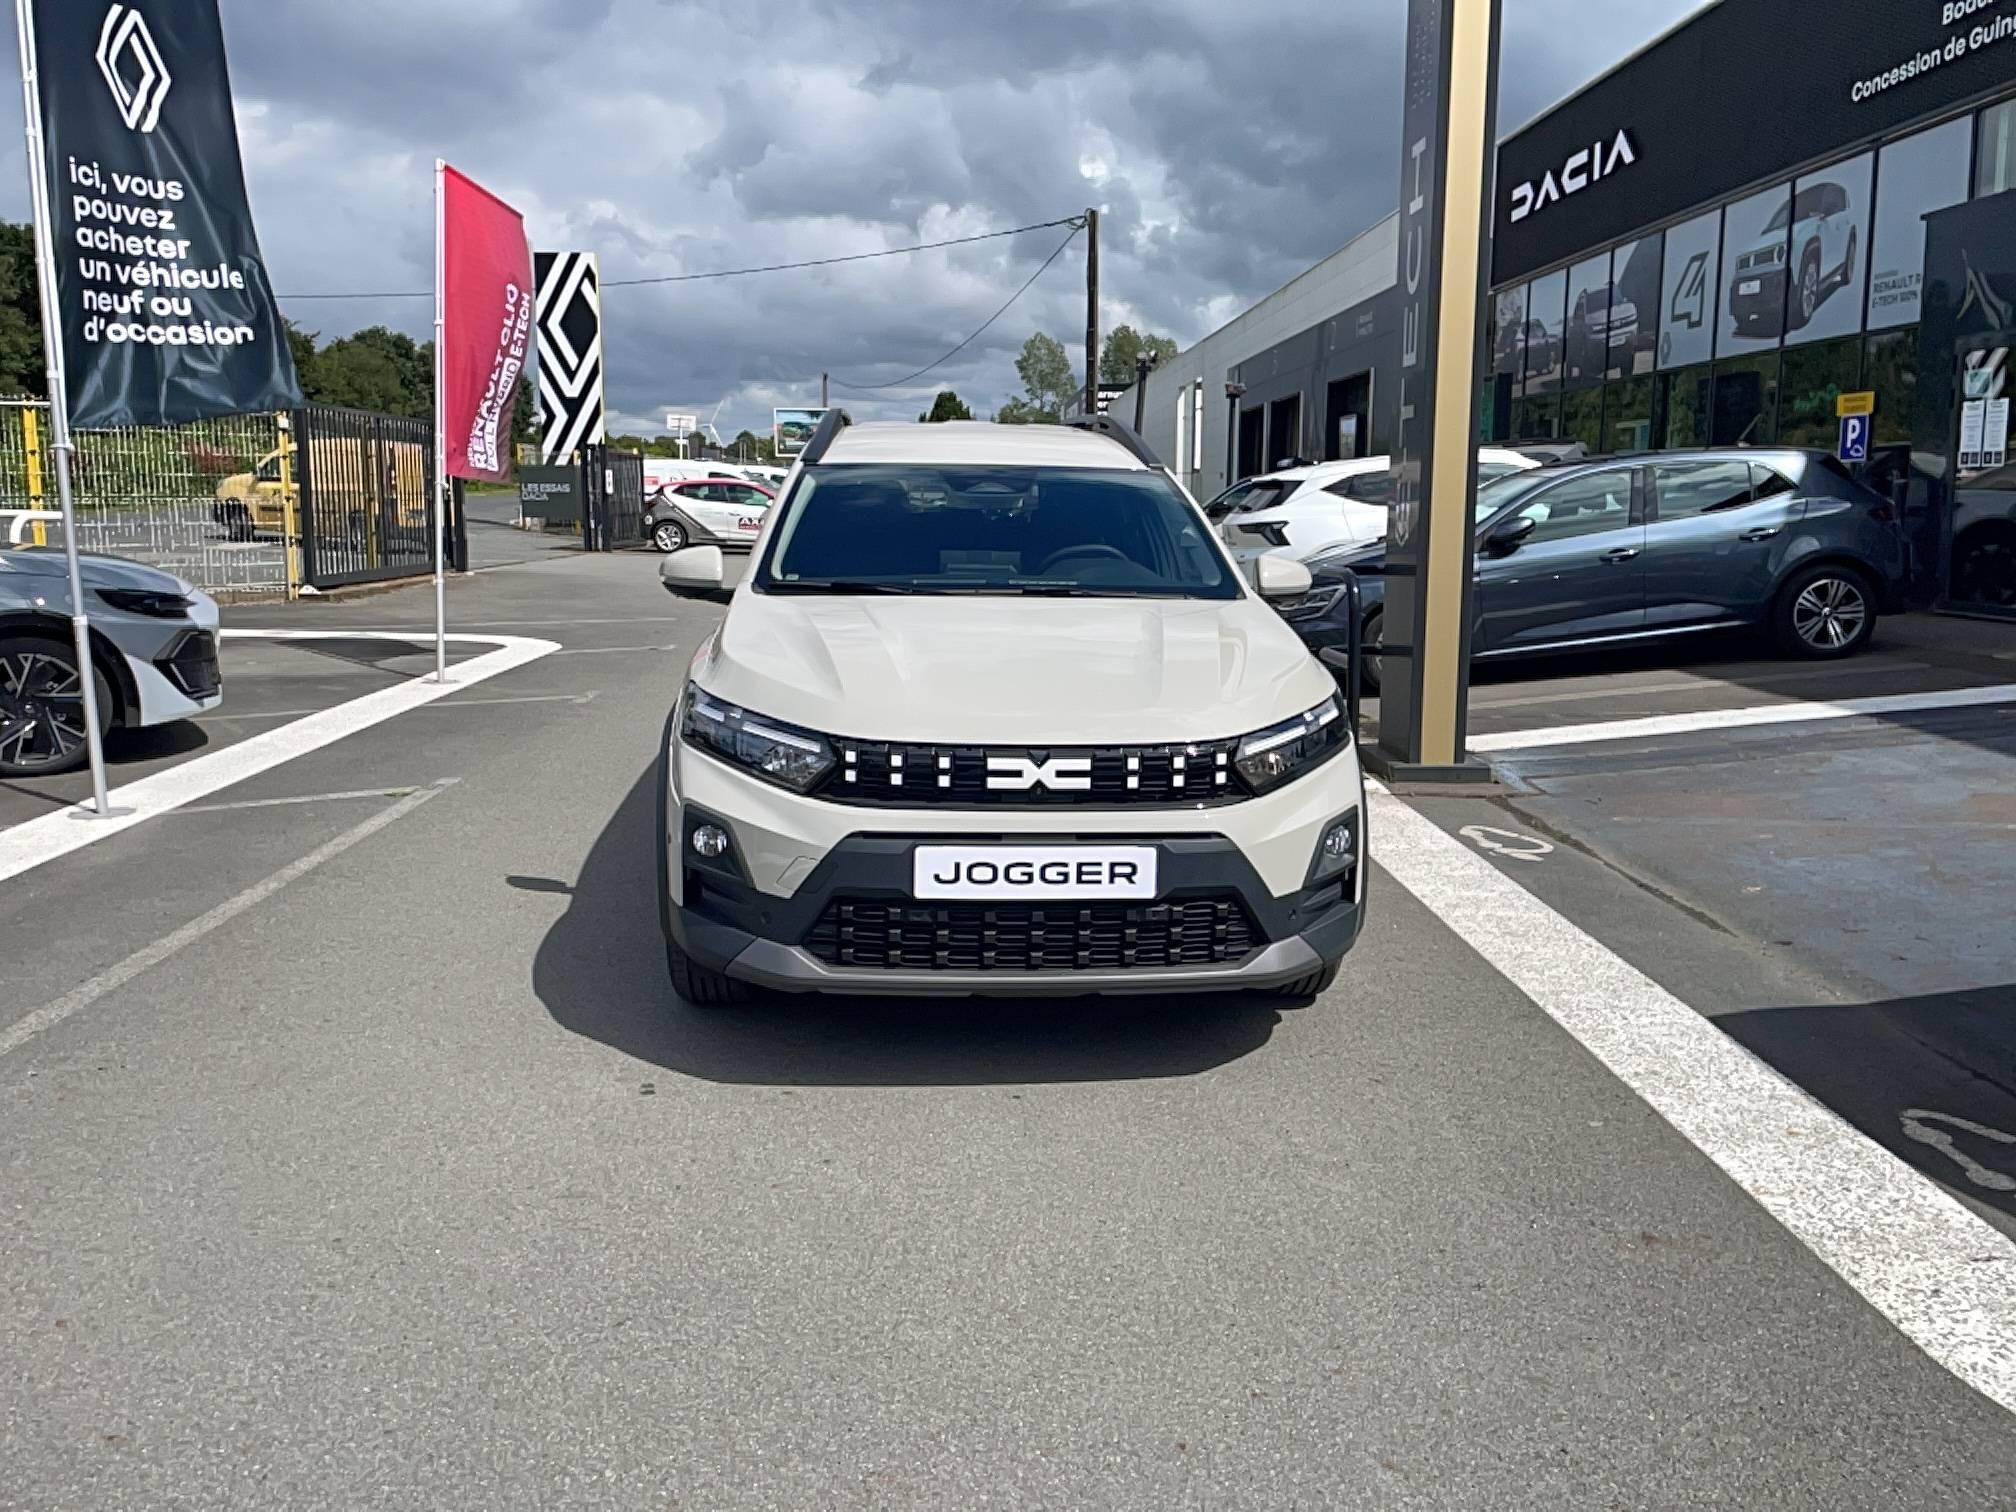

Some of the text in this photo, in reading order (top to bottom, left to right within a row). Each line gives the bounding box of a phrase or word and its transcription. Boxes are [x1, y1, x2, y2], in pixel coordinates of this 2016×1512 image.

[1851, 50, 1941, 102] Concession
[1943, 36, 1966, 62] de
[69, 156, 185, 200] ici, vous
[1511, 129, 1635, 223] DACIA
[73, 195, 176, 231] pouvez
[76, 225, 190, 260] acheter
[79, 257, 245, 290] un véhicule
[83, 288, 191, 316] neuf ou
[84, 315, 255, 346] d'occasion
[510, 292, 531, 358] E-TECH
[473, 283, 519, 468] RENAULT CLIO
[1847, 418, 1861, 449] P
[933, 861, 1138, 885] JOGGER
